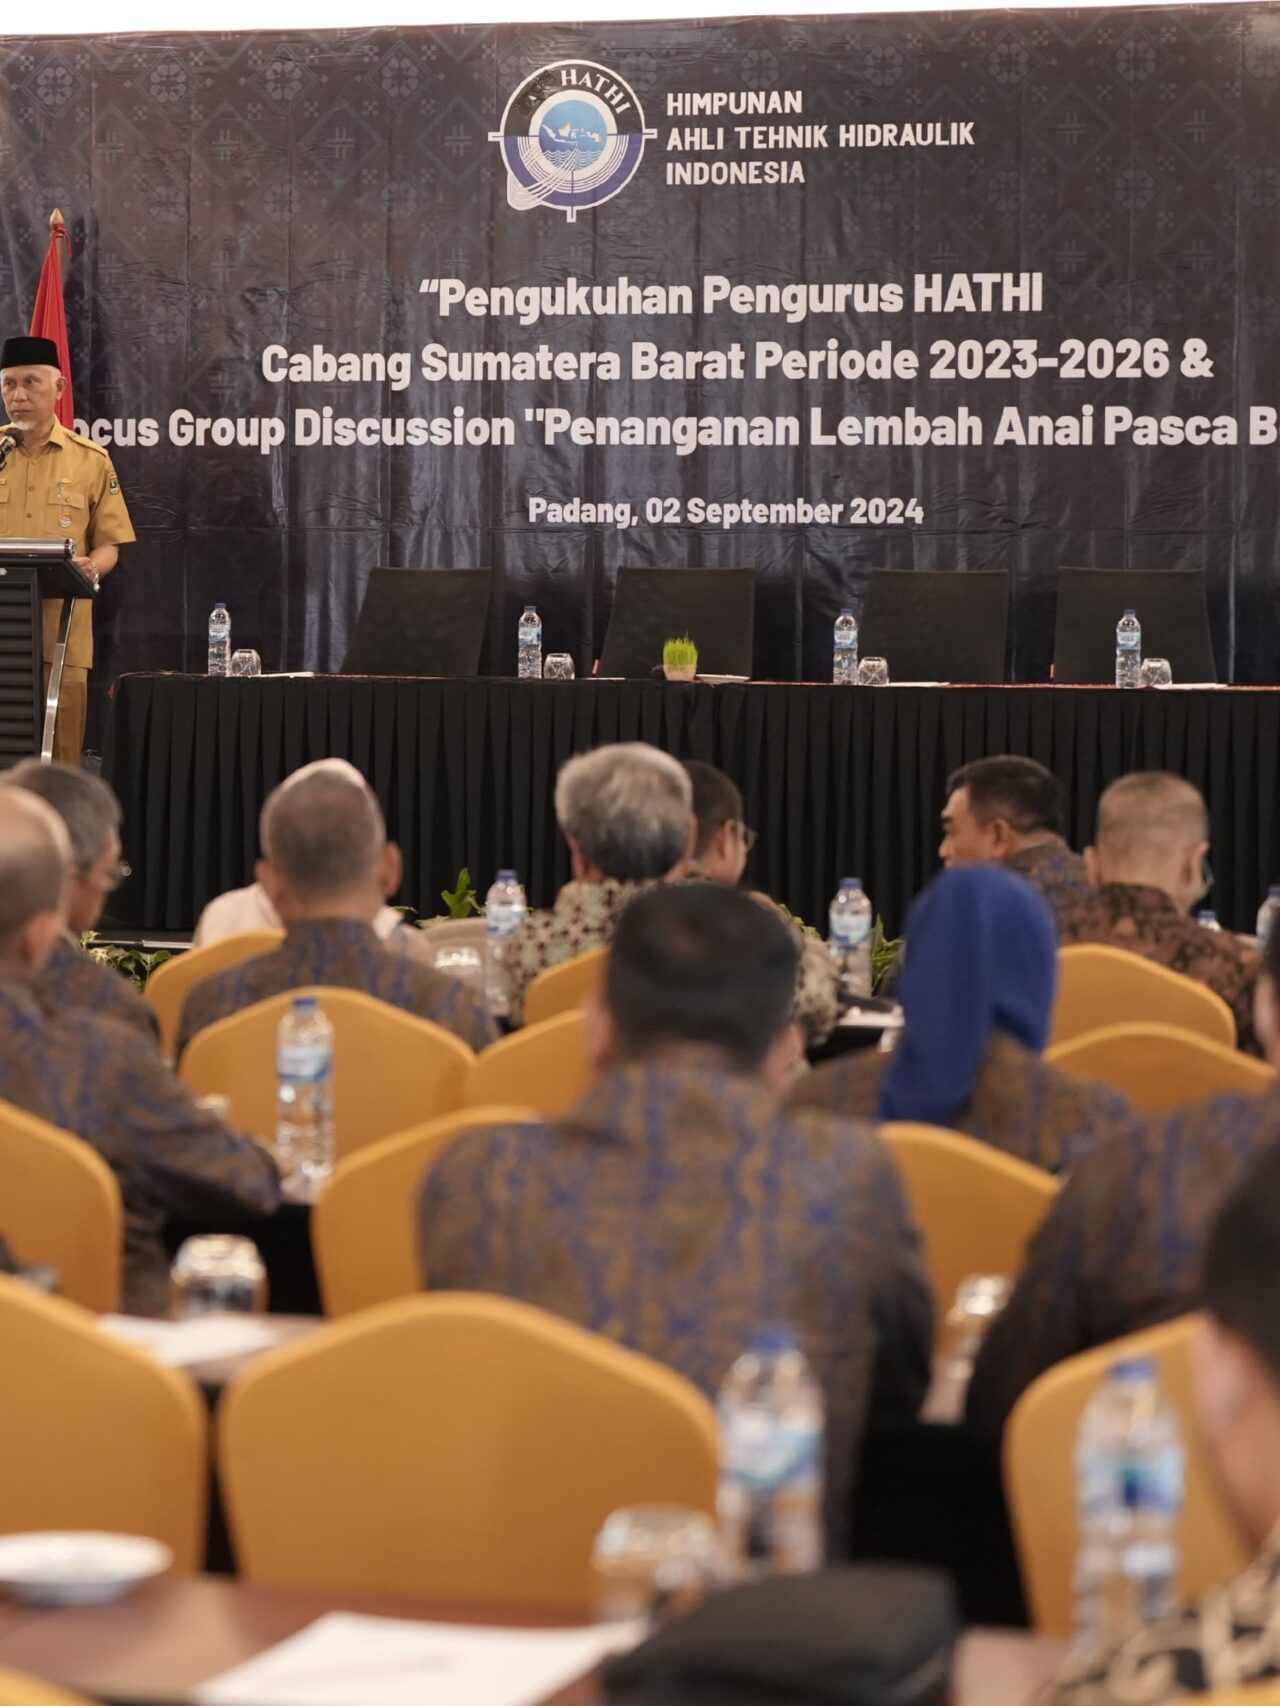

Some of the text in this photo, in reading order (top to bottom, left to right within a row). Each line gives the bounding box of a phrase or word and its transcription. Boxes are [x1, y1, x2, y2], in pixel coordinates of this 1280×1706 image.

[560, 68, 631, 115] HATHI
[667, 90, 803, 116] HIMPUNAN
[666, 121, 975, 151] AHLI TEHNIK HIDRAULIK
[666, 160, 805, 185] INDONESIA
[703, 275, 904, 324] Pengurus
[914, 272, 1043, 313] HATHI
[262, 337, 1214, 391] Cabang Sumatera Barat Periode 2023-2026 &
[73, 417, 160, 447] ocus
[168, 408, 286, 455] Group
[294, 405, 515, 446] Discussion
[810, 406, 983, 446] Lembah
[993, 404, 1094, 446] Anai
[1104, 406, 1238, 446] Pasca
[528, 497, 924, 530] Padang, 02 September 2024
